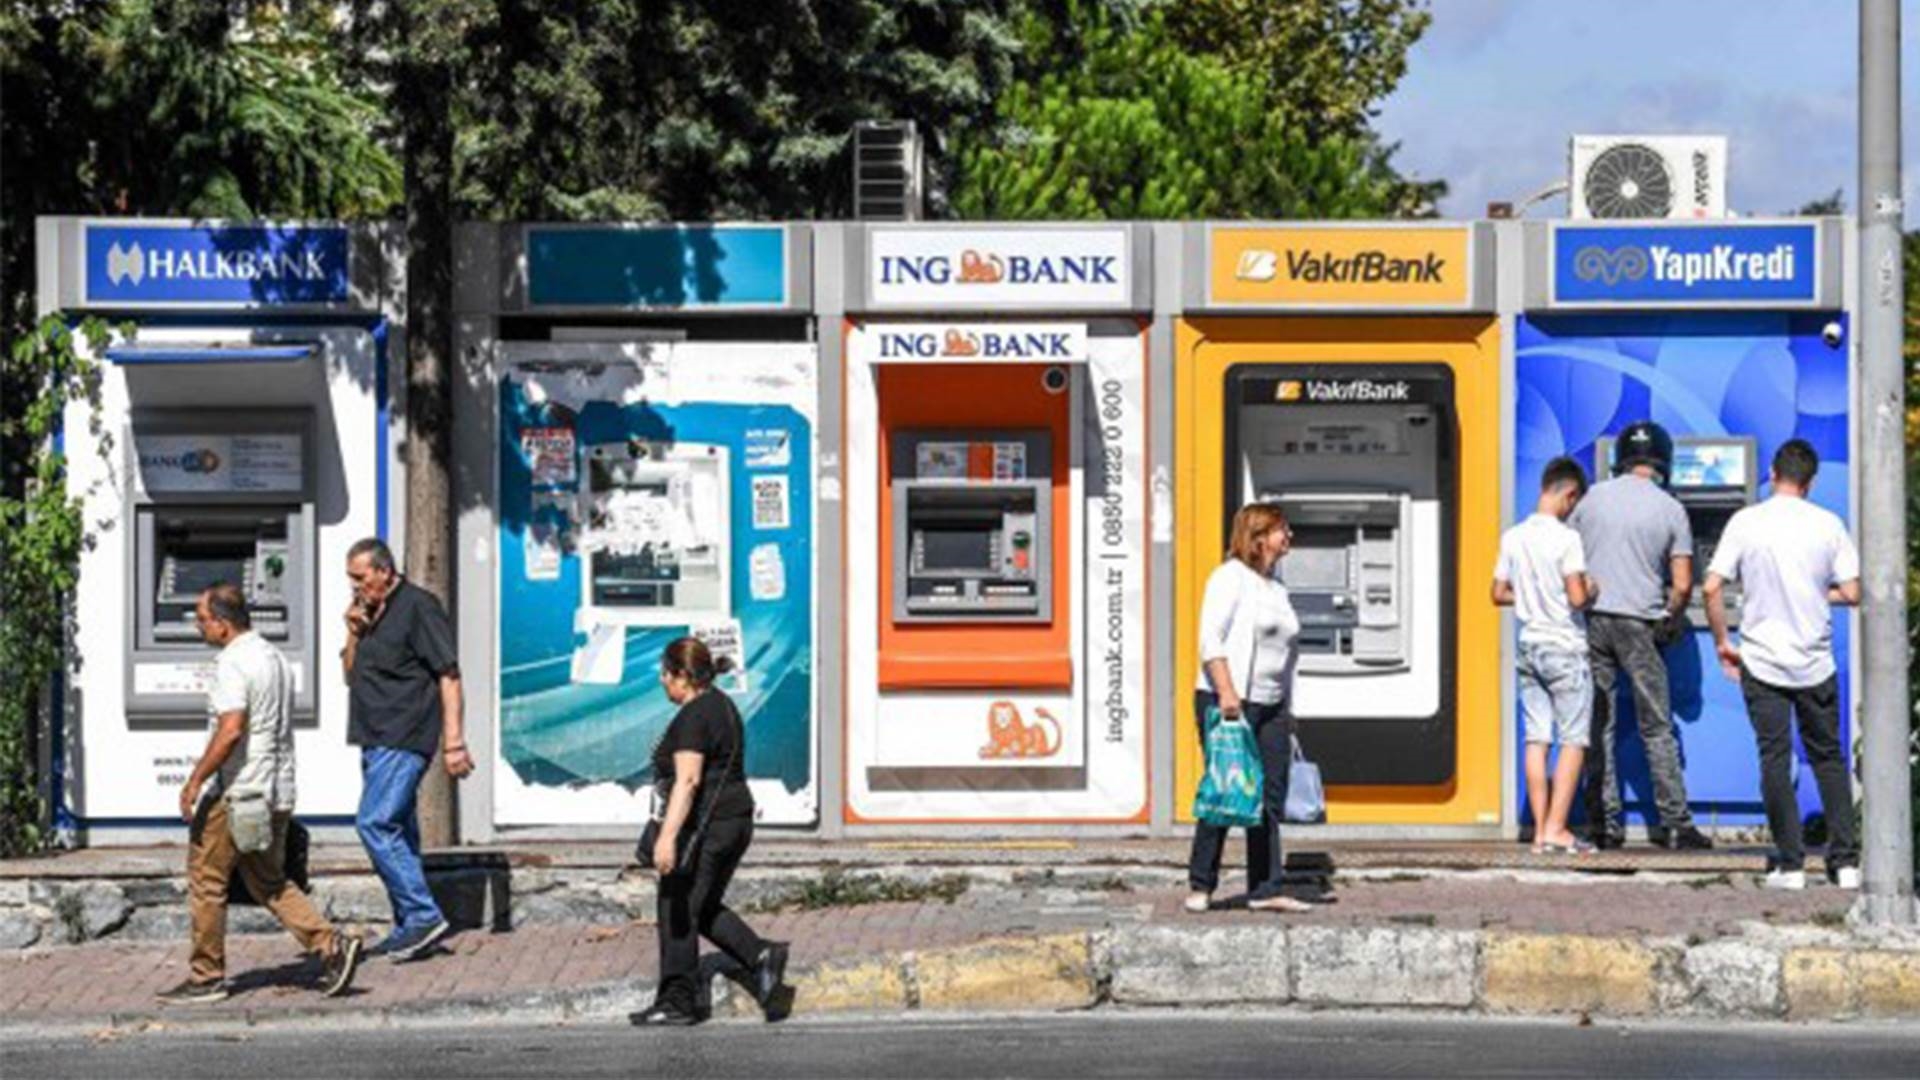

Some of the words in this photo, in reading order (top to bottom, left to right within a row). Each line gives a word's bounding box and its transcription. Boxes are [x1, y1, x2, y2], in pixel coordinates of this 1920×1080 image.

[149, 249, 325, 281] HALKBANK
[881, 256, 951, 284] ING
[1008, 256, 1116, 284] BANK
[1286, 250, 1445, 283] VakıfBank
[1650, 245, 1794, 286] YapıKredi
[880, 334, 937, 357] ING
[983, 334, 1071, 357] BANK
[1101, 380, 1122, 421] 600
[1306, 380, 1410, 401] VakıfBank
[1102, 425, 1121, 441] 0
[1101, 446, 1122, 486] 222
[1104, 567, 1127, 743] ingbank.com.tr
